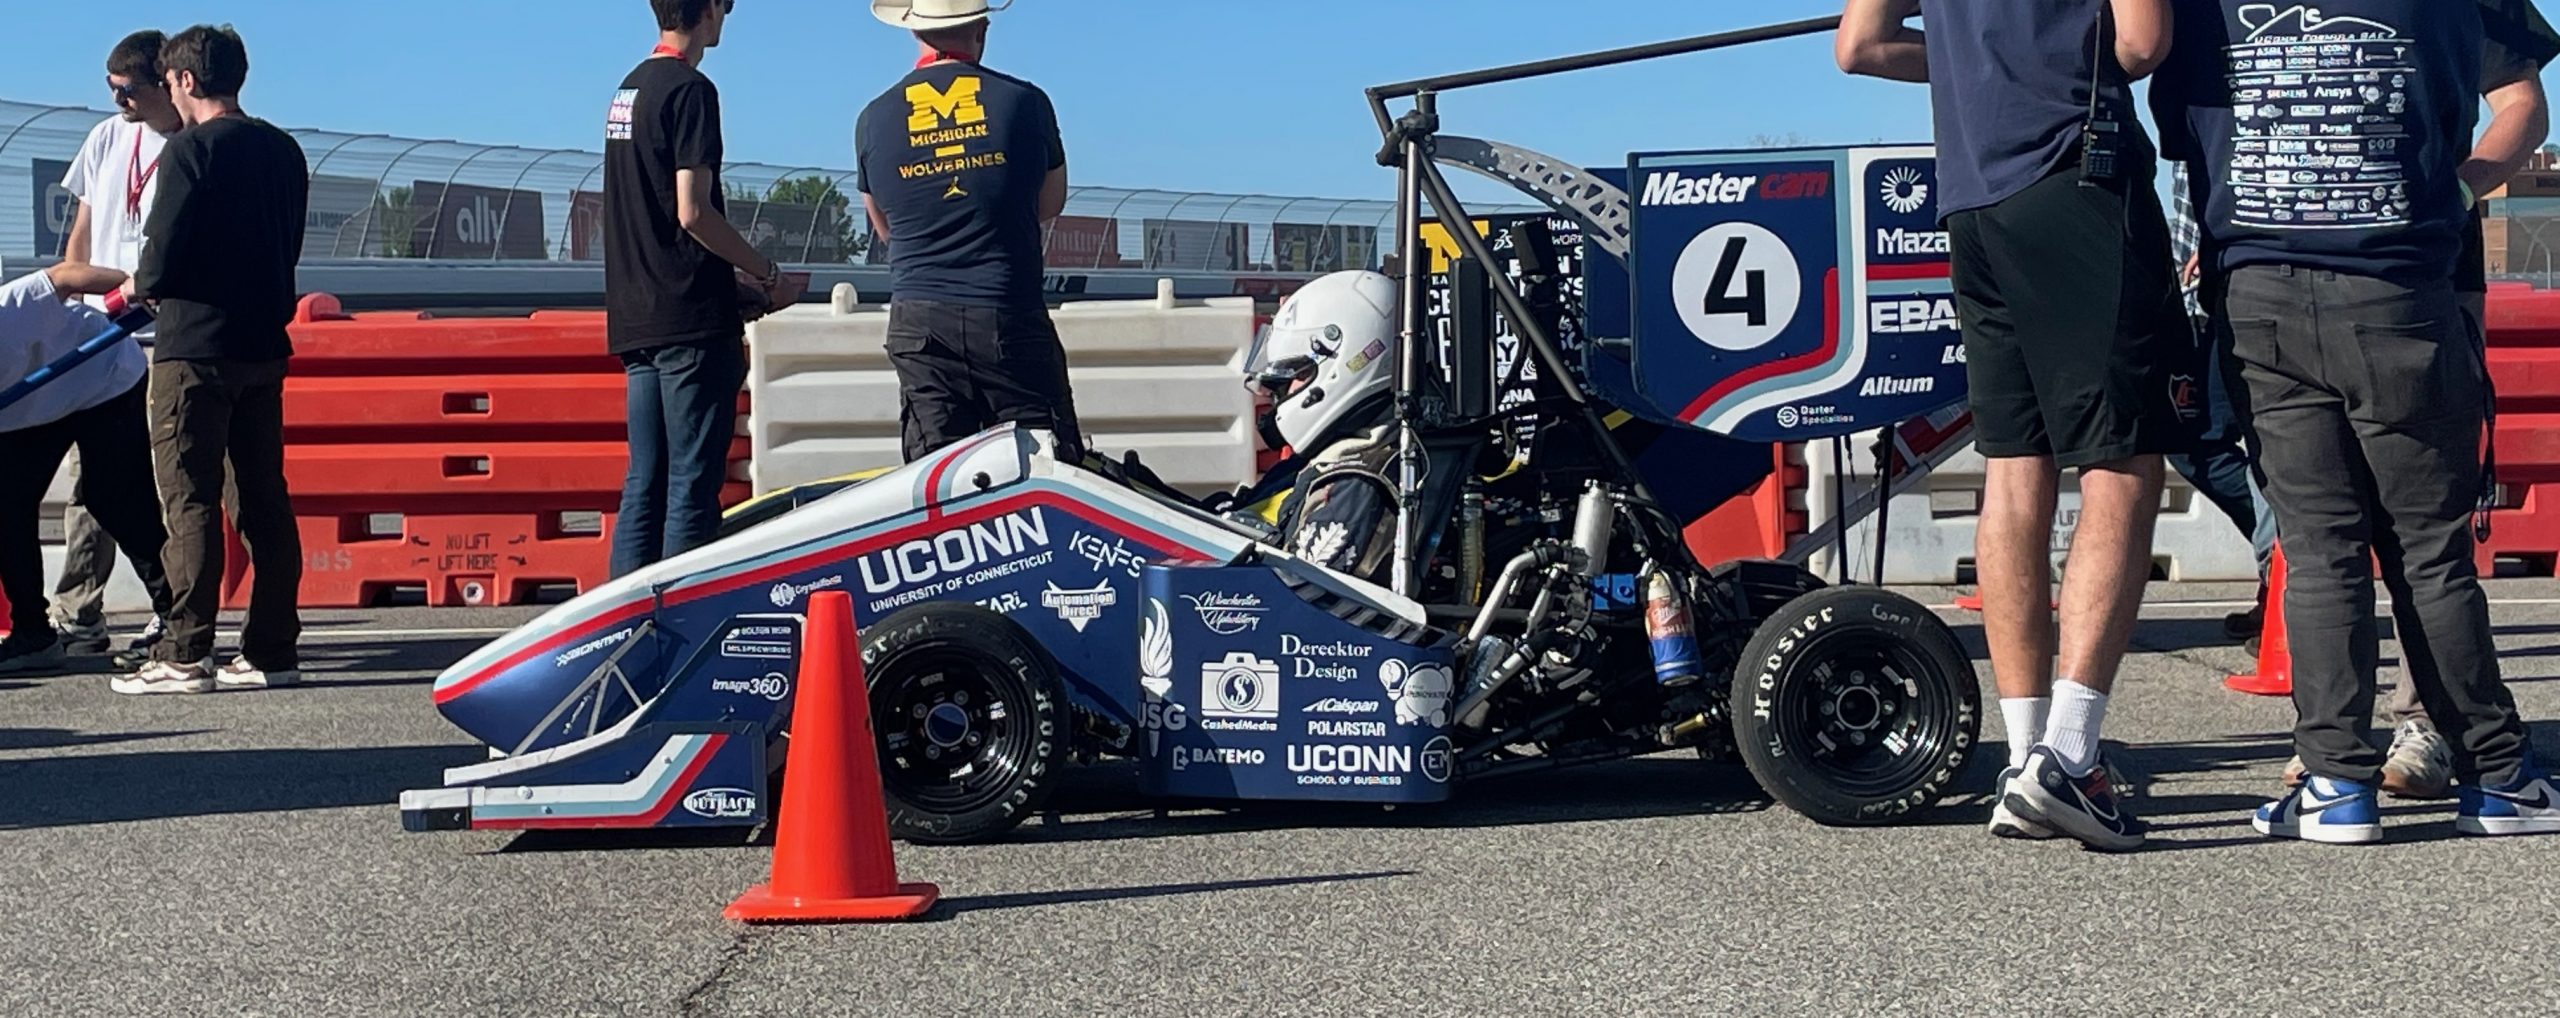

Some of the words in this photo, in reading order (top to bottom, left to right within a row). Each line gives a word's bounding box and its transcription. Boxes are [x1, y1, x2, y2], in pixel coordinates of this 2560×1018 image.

[906, 76, 985, 132] M
[2314, 86, 2353, 100] Ansys
[910, 124, 988, 148] MICHIGAN
[899, 152, 1007, 179] WOLVERINES
[1640, 171, 1757, 207] Master
[1759, 171, 1829, 199] cam
[1703, 236, 1767, 327] 4
[1870, 300, 1963, 333] EBA
[1859, 375, 1934, 397] Altium
[465, 532, 491, 550] LIFT
[857, 505, 1050, 594] UCONN
[438, 554, 464, 571] LIFT
[467, 553, 499, 570] HERE
[869, 579, 944, 613] UNIVERSITY
[946, 575, 963, 592] OF
[965, 550, 1053, 586] CONNECTICUT
[1044, 592, 1114, 606] Automation
[1061, 604, 1098, 617] Direct
[1279, 634, 1374, 658] Derecktor
[1294, 656, 1359, 683] Design
[1754, 606, 1834, 724] Hoosier
[1321, 697, 1379, 715] Calspan
[1201, 718, 1278, 731] CashedMedia
[1308, 720, 1386, 737] POLARSTAR
[1192, 747, 1266, 765] BATEMO
[1287, 744, 1411, 772] UCONN
[1338, 775, 1352, 785] OF
